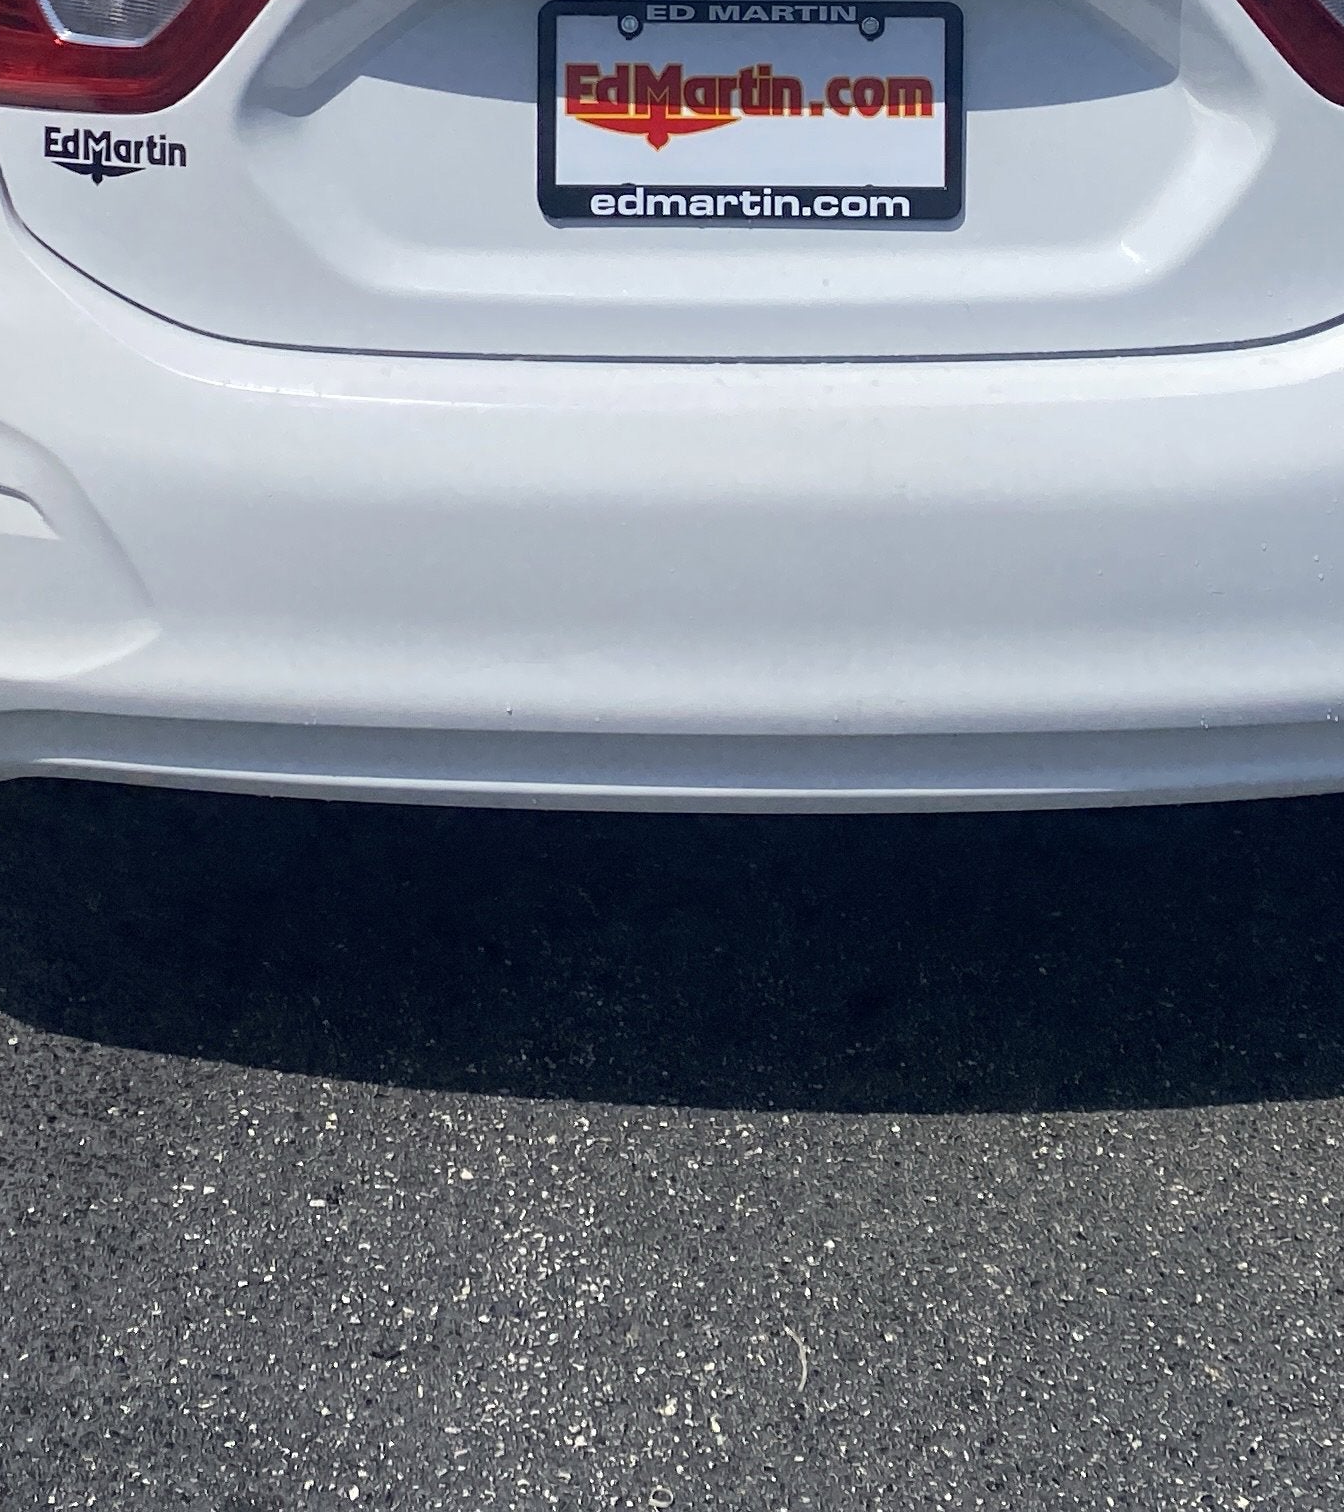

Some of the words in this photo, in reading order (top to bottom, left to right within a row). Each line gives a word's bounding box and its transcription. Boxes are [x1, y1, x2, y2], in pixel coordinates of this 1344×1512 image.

[645, 4, 695, 21] ED
[708, 4, 857, 22] MARTIN
[564, 62, 936, 118] EdMartin.com
[44, 125, 187, 168] EdMartin
[590, 187, 912, 218] edmartin.com
